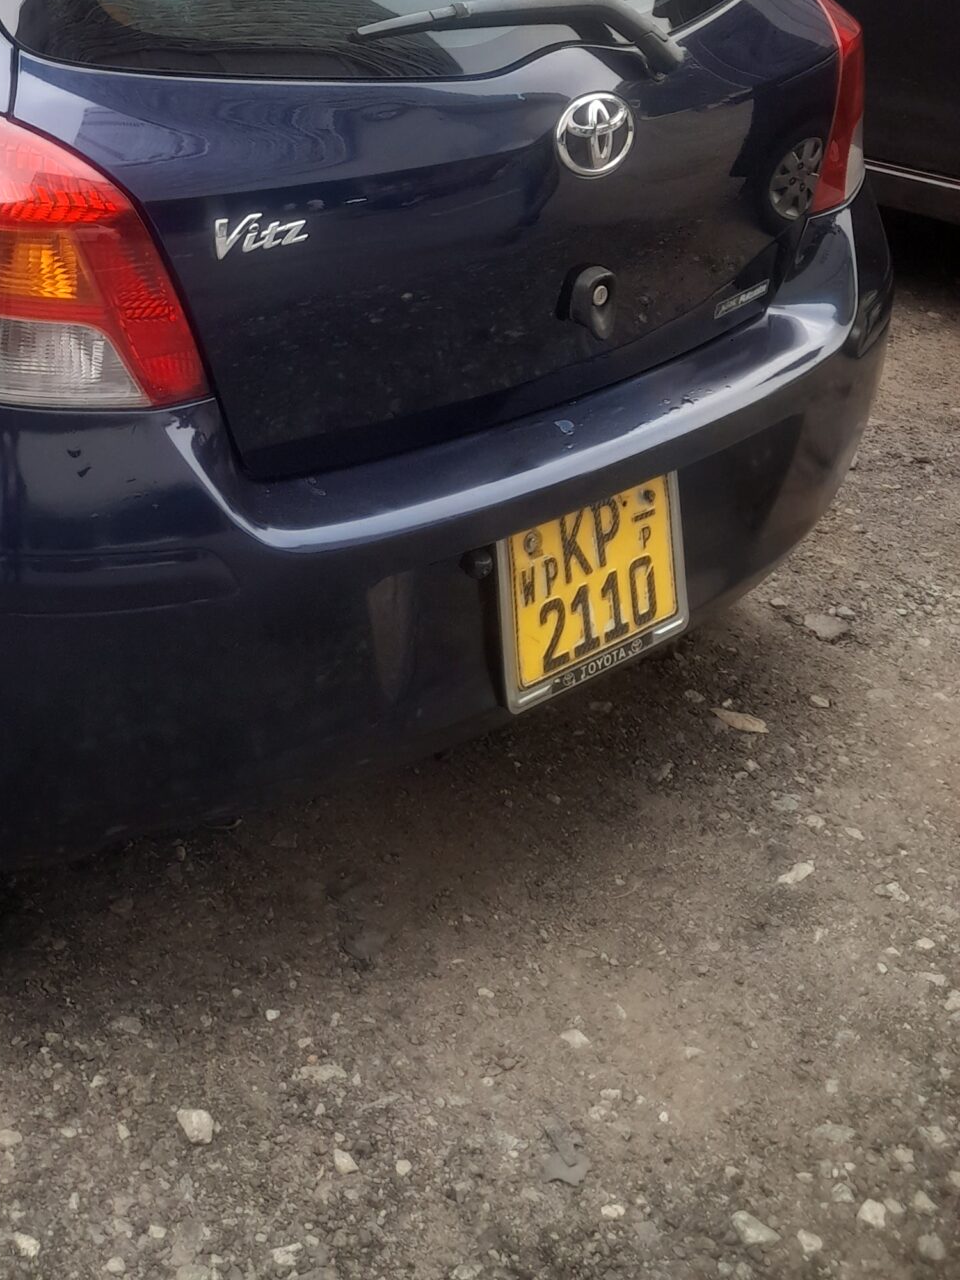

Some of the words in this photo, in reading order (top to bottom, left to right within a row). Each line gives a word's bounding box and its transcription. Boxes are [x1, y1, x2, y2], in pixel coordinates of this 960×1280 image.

[214, 212, 309, 260] Vitz
[520, 556, 559, 608] WP
[539, 555, 658, 674] 2110
[580, 648, 627, 680] TOYOTA
